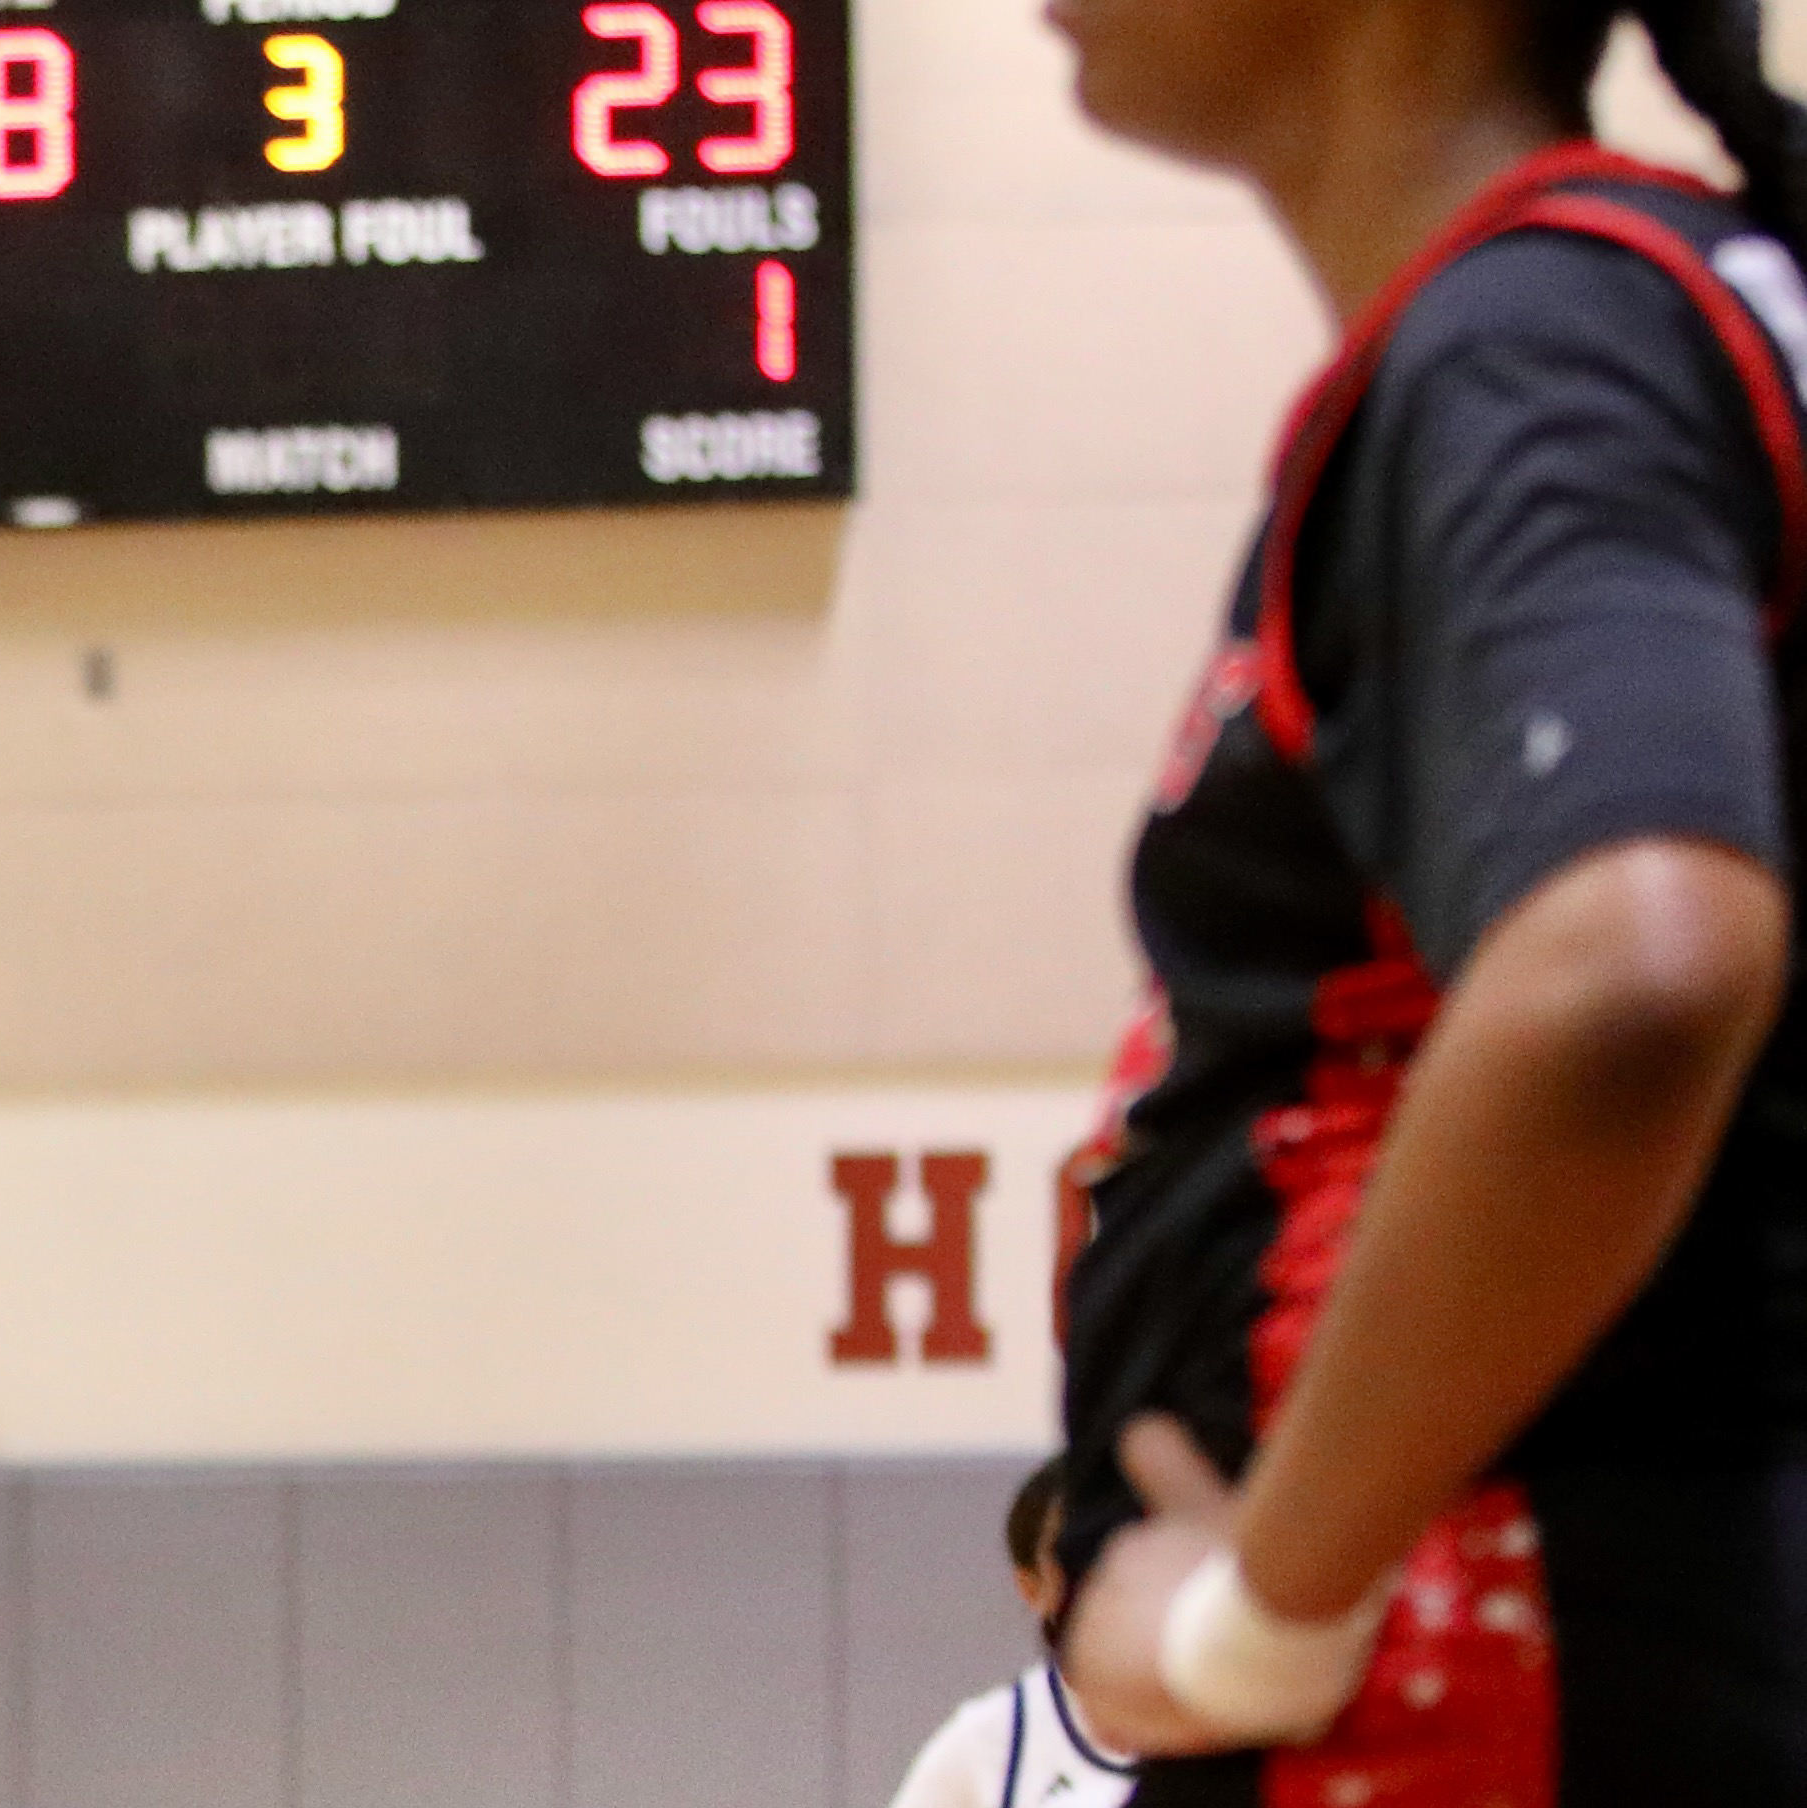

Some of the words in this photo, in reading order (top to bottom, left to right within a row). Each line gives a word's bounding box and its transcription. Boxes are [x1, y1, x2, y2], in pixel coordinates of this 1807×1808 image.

[263, 33, 345, 173] 3
[571, 0, 792, 178] 23
[128, 206, 334, 273] PLAYER
[341, 196, 485, 265] FOUL
[639, 182, 819, 254] FOULS
[755, 259, 796, 382] 1
[205, 425, 399, 494] MATCH
[640, 409, 822, 483] SCORE
[828, 1150, 1077, 1366] H
